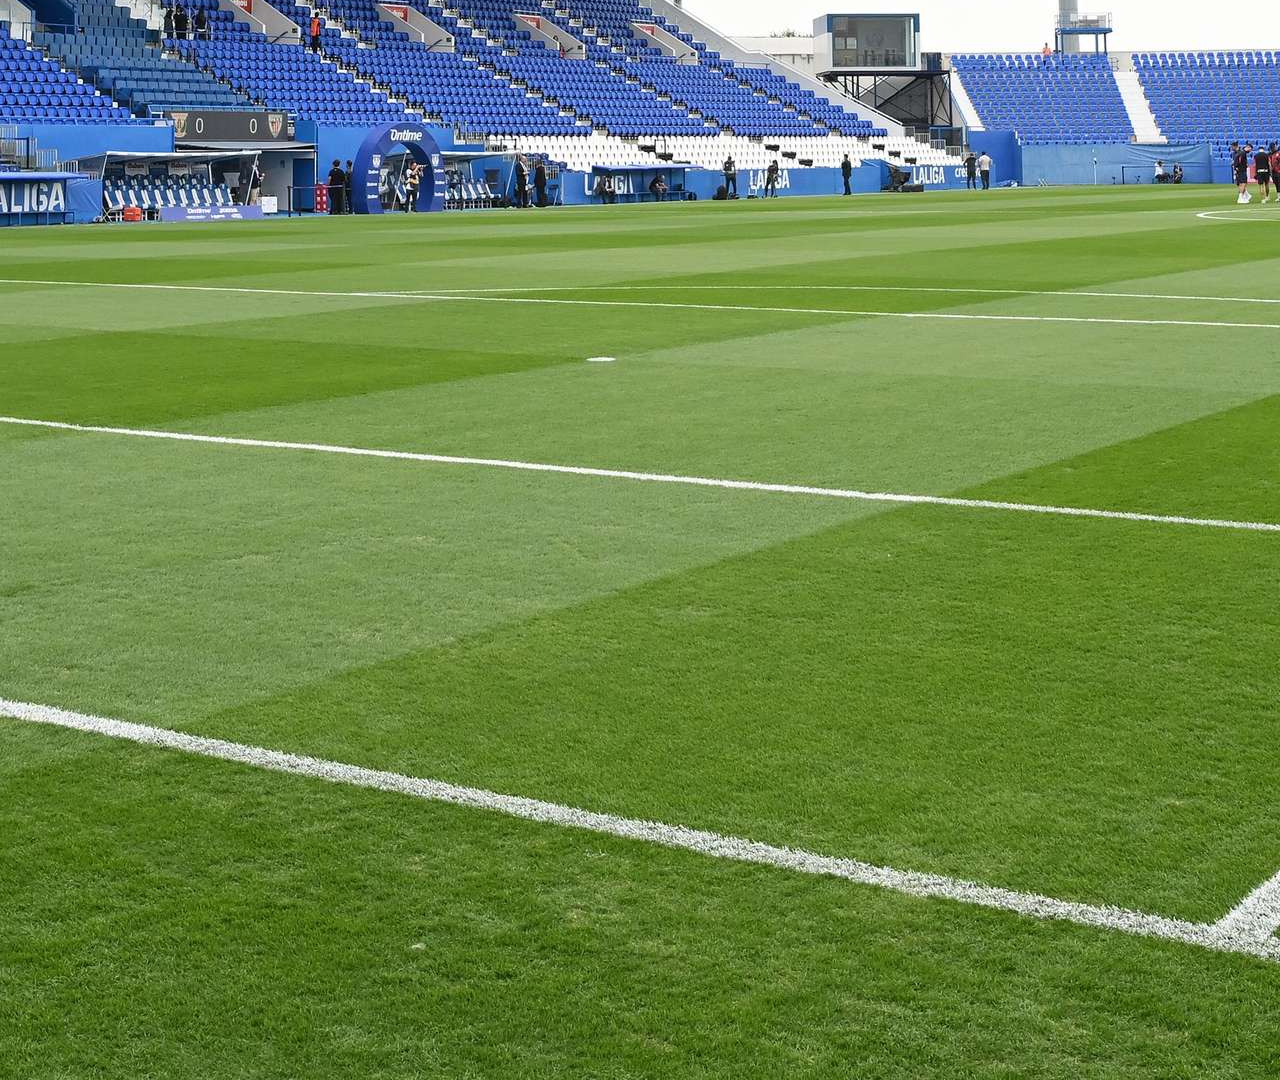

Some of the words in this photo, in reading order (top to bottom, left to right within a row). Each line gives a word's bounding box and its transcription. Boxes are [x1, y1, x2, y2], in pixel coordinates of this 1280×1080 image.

[195, 118, 204, 134] 0
[249, 118, 258, 134] 0
[390, 129, 423, 141] Ontime
[913, 166, 945, 184] LALIGA
